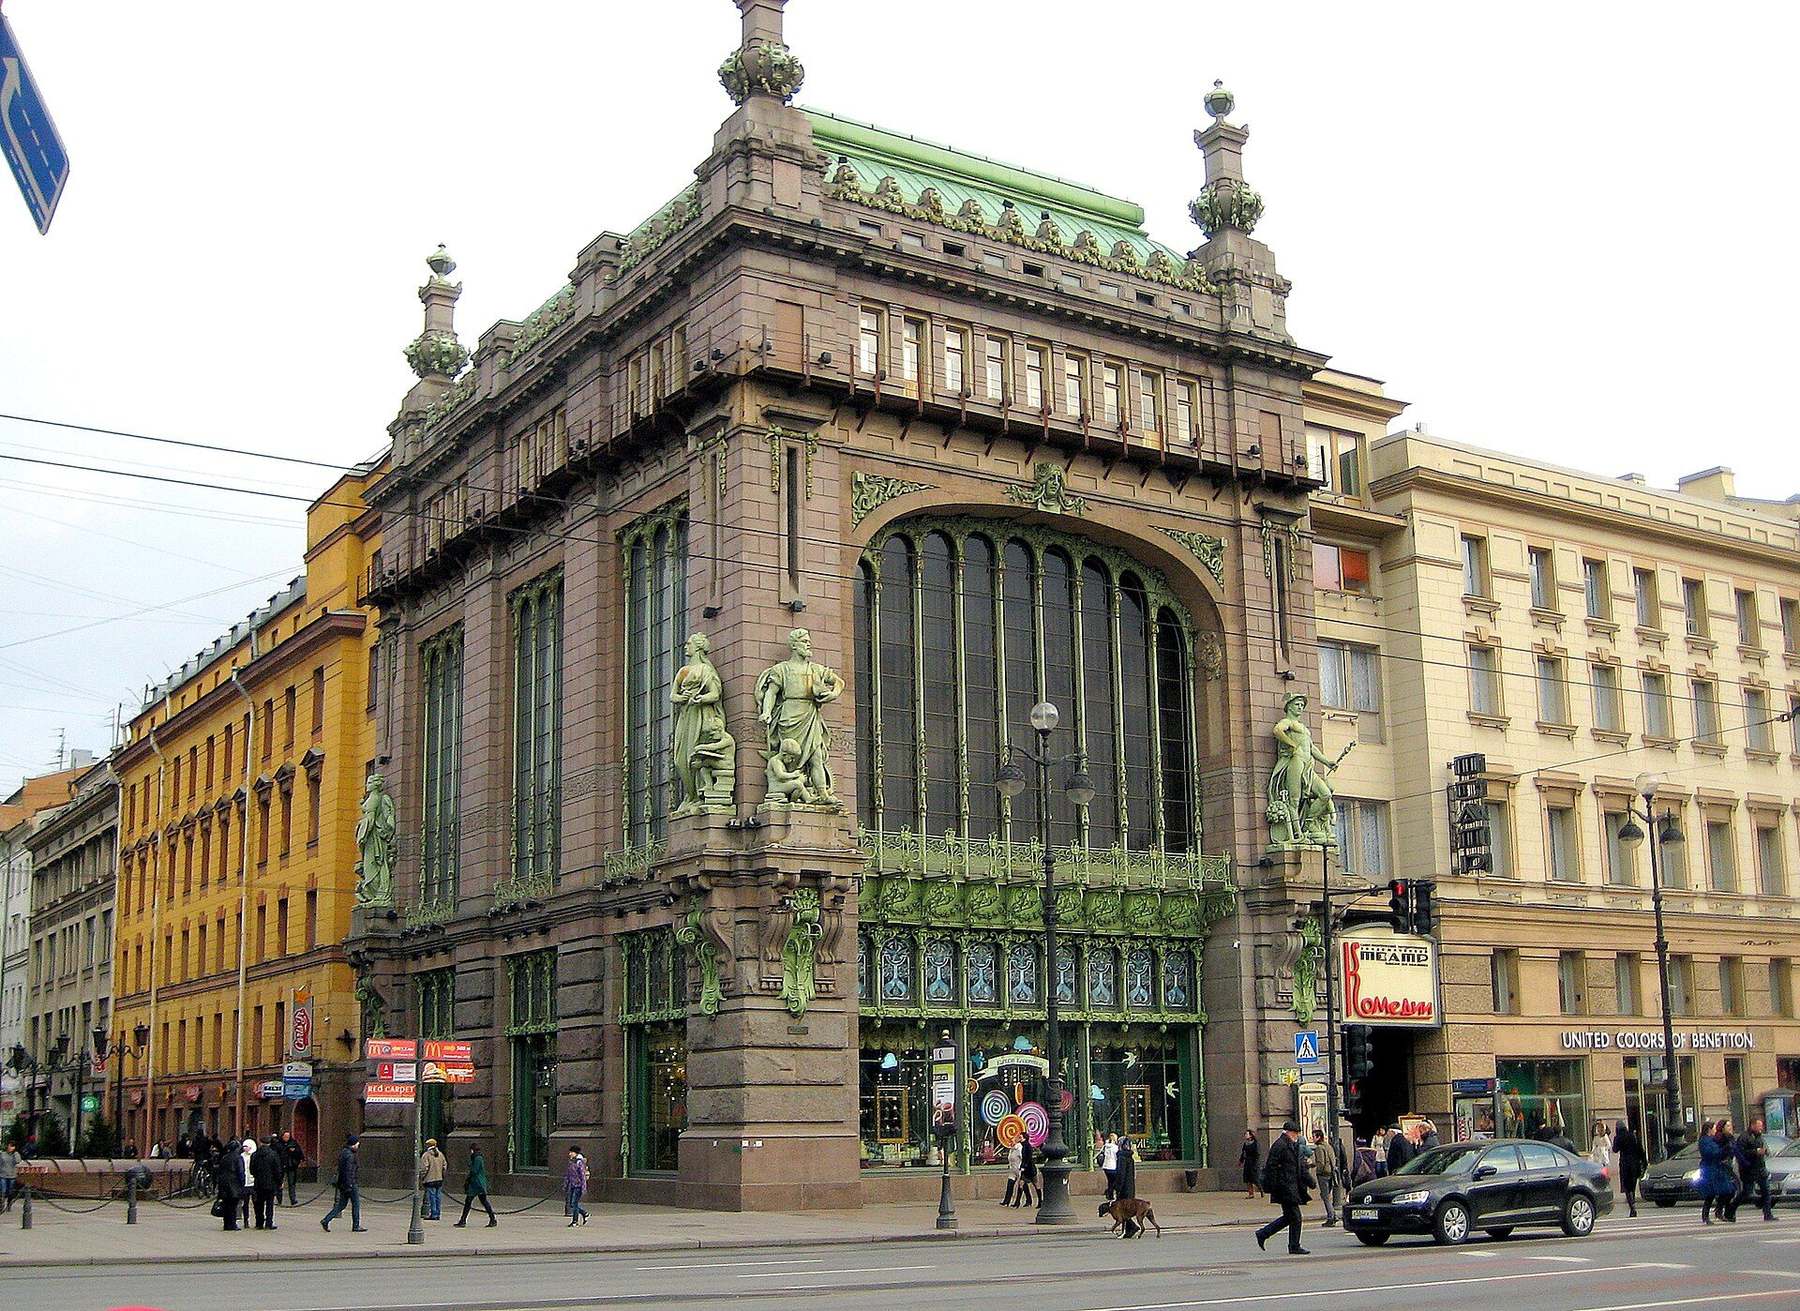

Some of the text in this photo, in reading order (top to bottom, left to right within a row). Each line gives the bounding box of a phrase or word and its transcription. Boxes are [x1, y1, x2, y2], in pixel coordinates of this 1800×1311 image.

[1561, 1032, 1609, 1048] UNITED
[1616, 1032, 1666, 1048] COLORS
[1672, 1033, 1686, 1048] OF
[367, 1084, 416, 1094] RED CARPET
